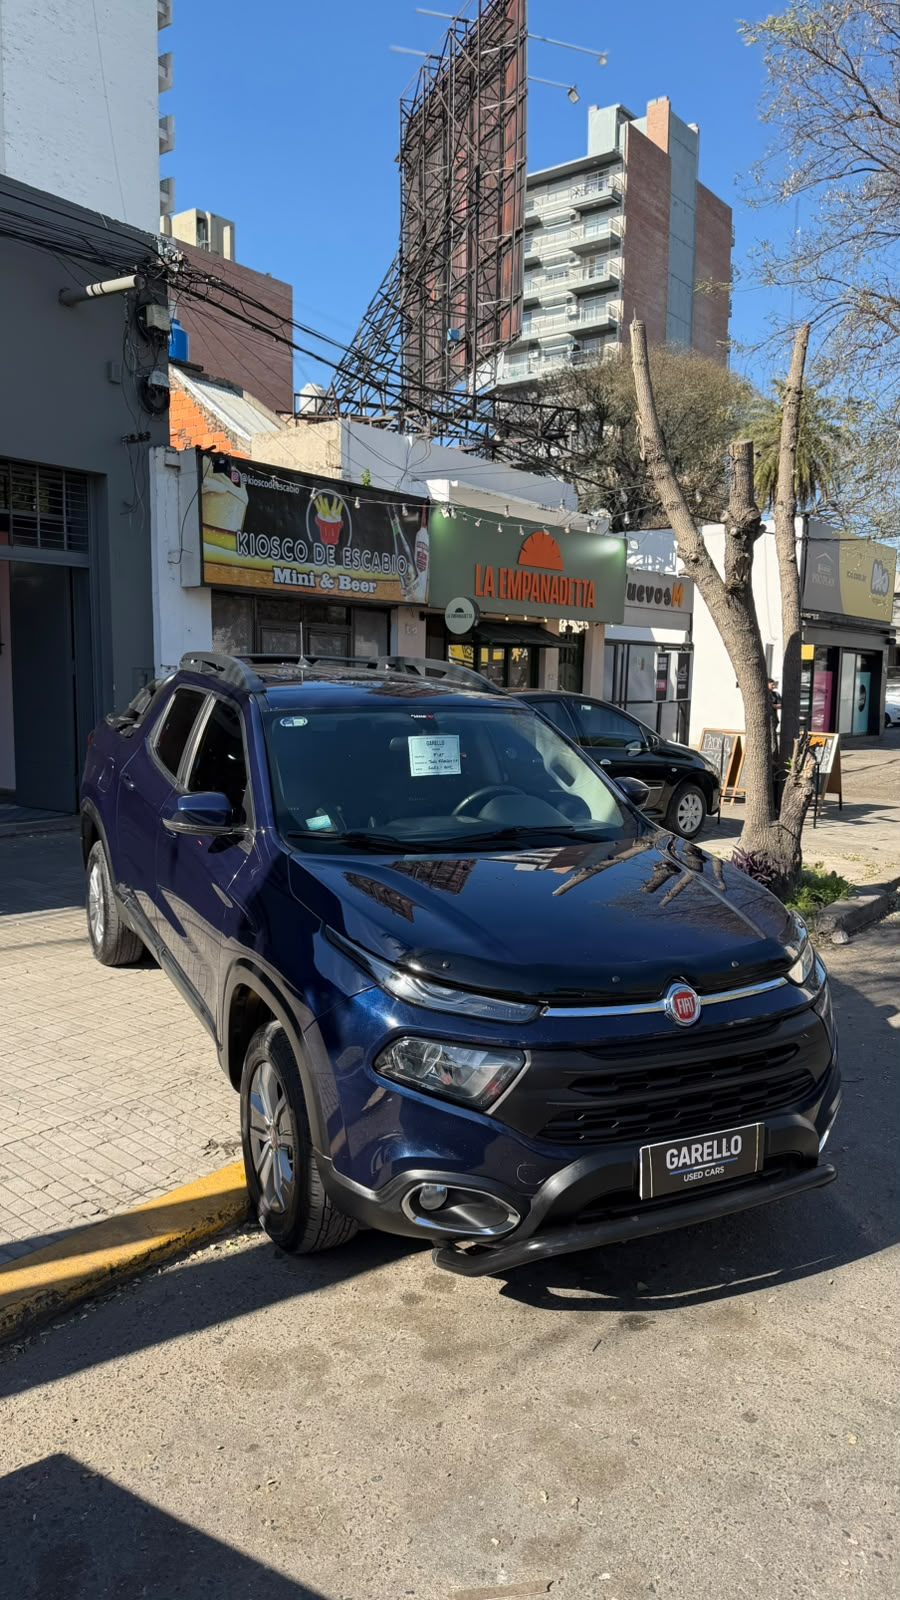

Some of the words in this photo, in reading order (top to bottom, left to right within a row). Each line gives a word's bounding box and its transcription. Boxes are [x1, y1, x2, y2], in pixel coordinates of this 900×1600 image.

[236, 532, 309, 564] KIOSCO
[313, 544, 336, 566] DE
[343, 546, 408, 576] ESCABIO
[273, 566, 315, 587] Mini
[320, 573, 335, 589] &
[339, 574, 377, 593] Beer
[475, 563, 496, 599] LA
[676, 997, 695, 1014] FIAT
[666, 1134, 743, 1170] GARELLO
[683, 1170, 704, 1182] USED
[704, 1166, 725, 1179] CARS
